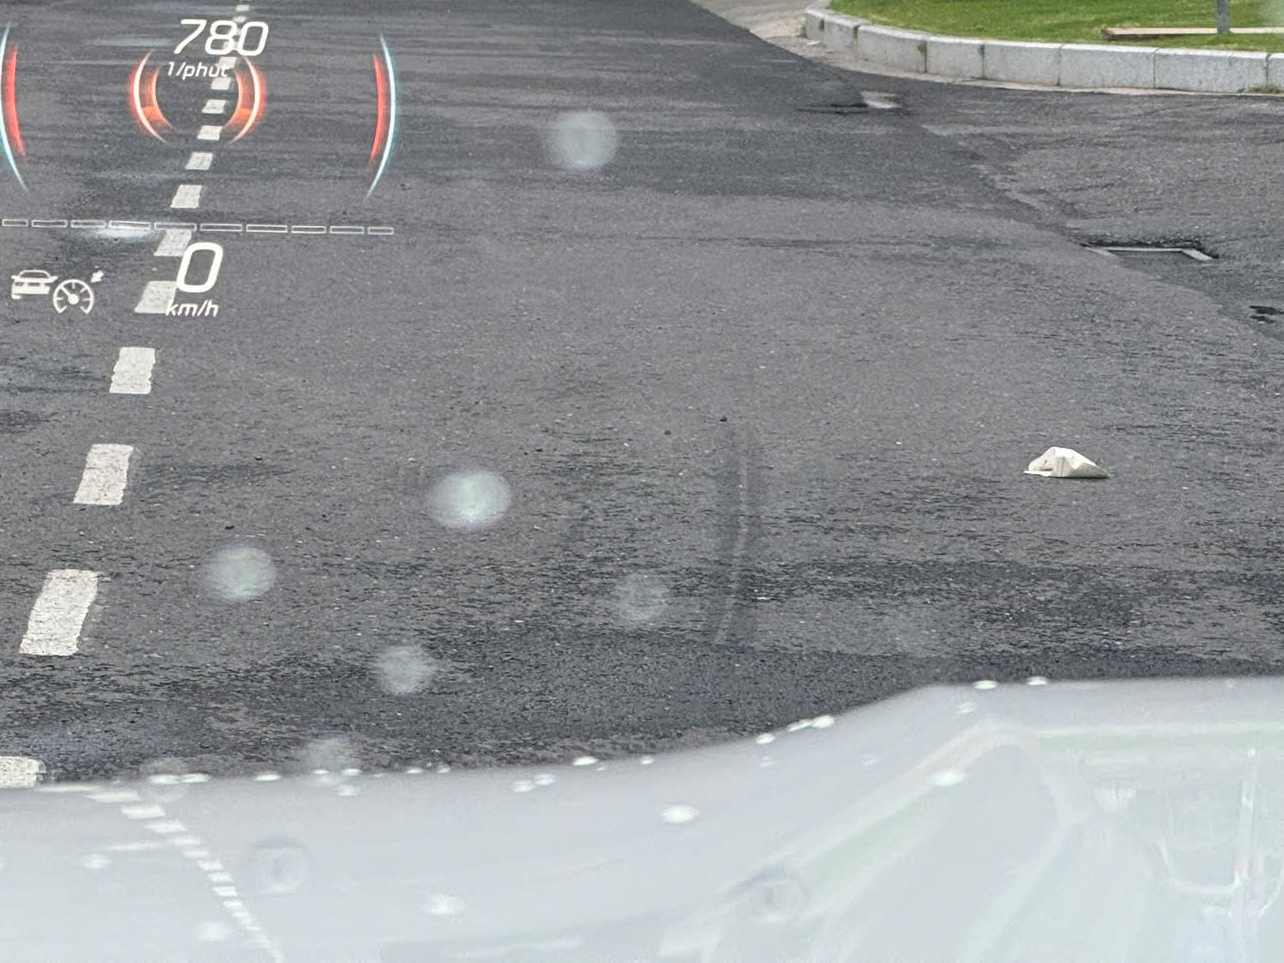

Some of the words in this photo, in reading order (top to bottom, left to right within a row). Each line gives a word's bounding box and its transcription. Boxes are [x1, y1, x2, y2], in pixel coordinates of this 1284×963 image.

[174, 19, 269, 56] 780
[176, 242, 223, 293] 0
[165, 299, 219, 317] km/h
